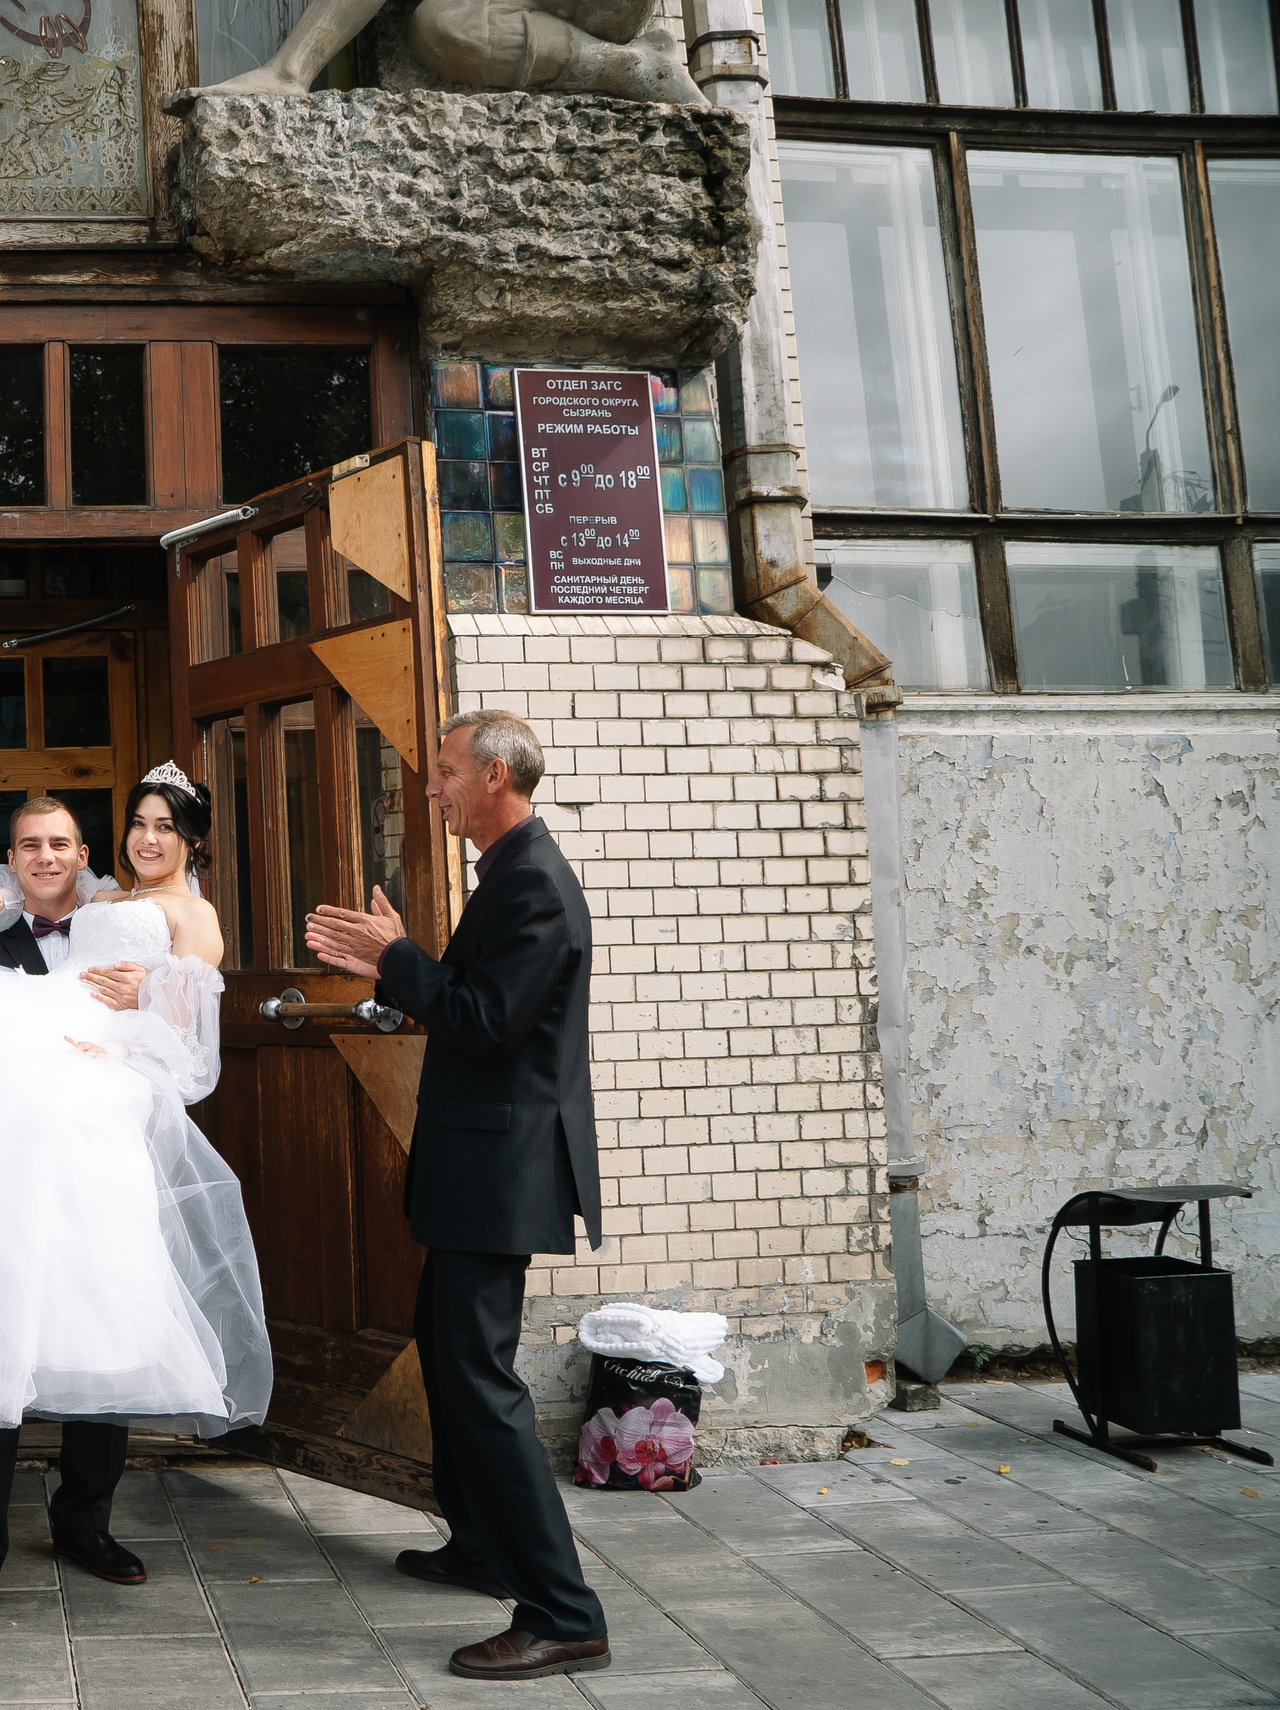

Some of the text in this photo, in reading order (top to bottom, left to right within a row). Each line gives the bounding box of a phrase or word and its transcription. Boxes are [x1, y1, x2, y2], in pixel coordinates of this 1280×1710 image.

[546, 380, 622, 391] ОТДЕЛ ЗАГС
[532, 396, 639, 407] ГОРОДСКОГО ОКРУГА
[563, 409, 612, 418] СЫЗРАНЬ
[538, 424, 639, 436] РЕЖИМ РАБОТЫ
[531, 448, 547, 458] ВТ
[532, 462, 550, 472] СР
[533, 476, 550, 486] ЧТ
[534, 489, 551, 500] ПТ
[535, 504, 554, 514] СБ
[569, 516, 617, 524] ПЕРЕРЫВ
[549, 551, 564, 559] ВС
[550, 562, 565, 570] ПН
[572, 558, 641, 566] ВЫХОДНЫЕ ДНИ
[554, 575, 645, 585] САНИТАРНЫЙ ДЕНЬ
[550, 585, 650, 594] ПОСЛЕДНИЙ ЧЕТВЕРГ
[558, 596, 644, 605] КАЖДОГО МЕСЯЦА
